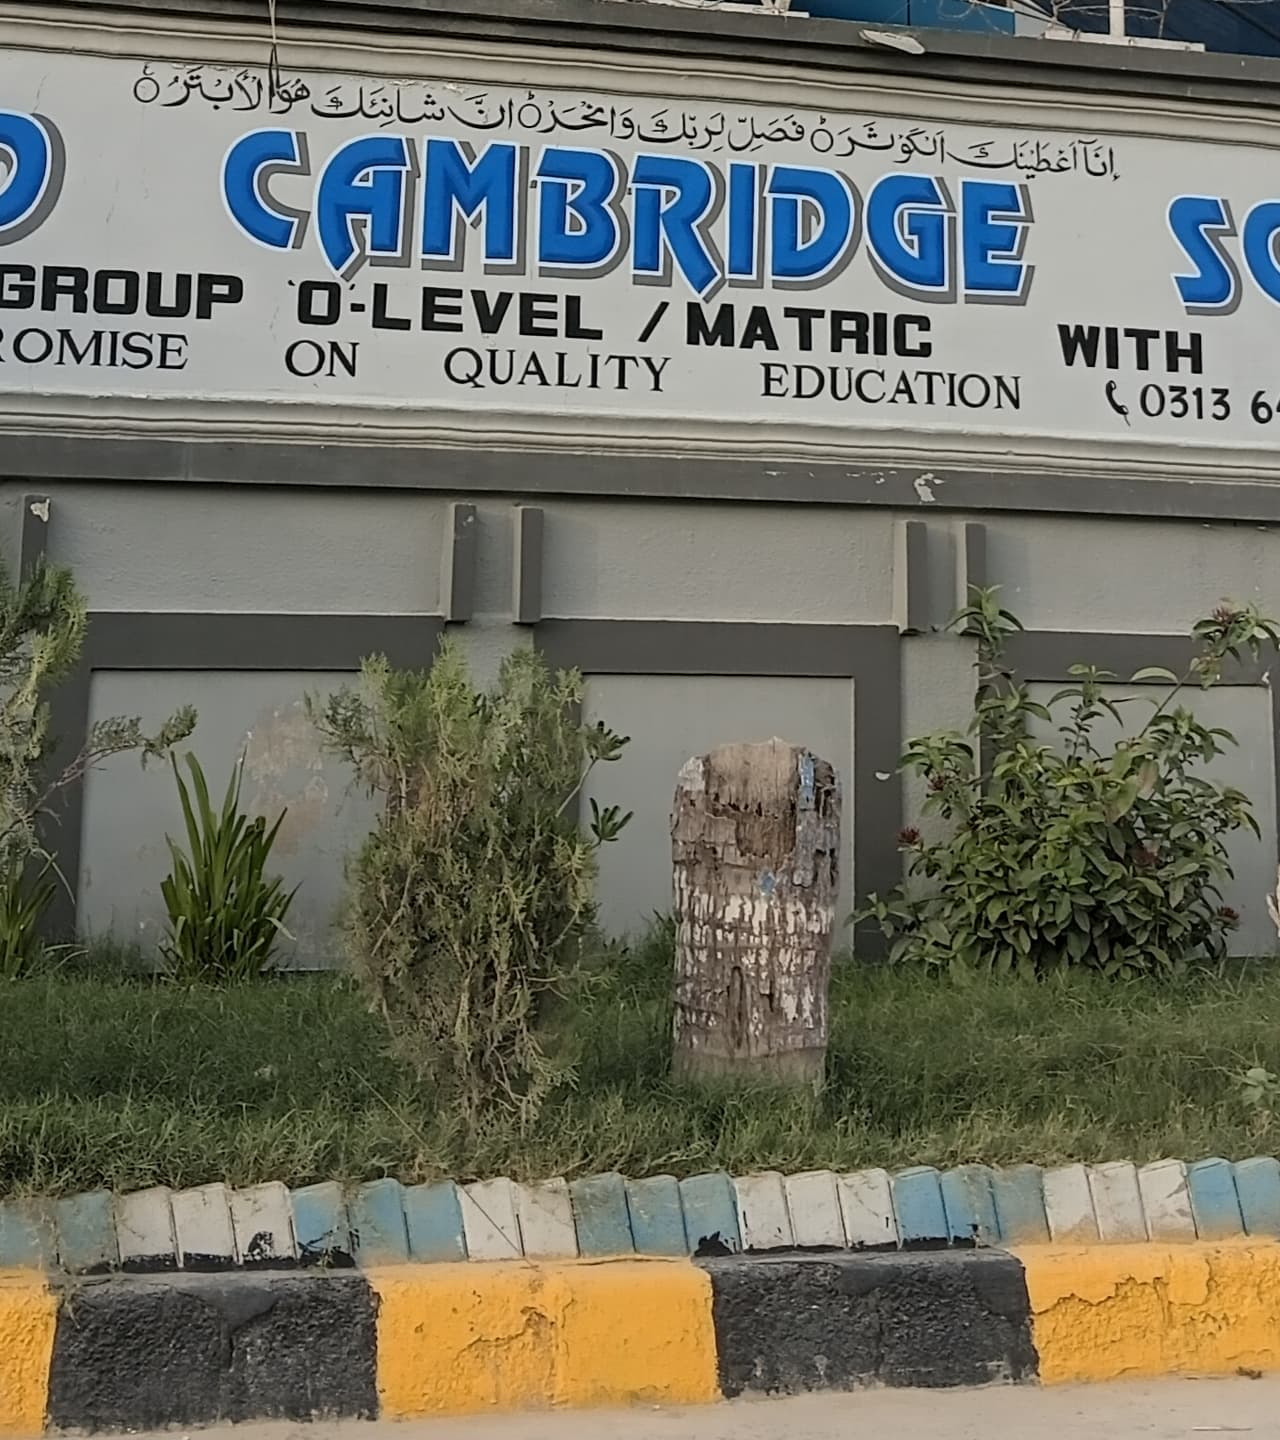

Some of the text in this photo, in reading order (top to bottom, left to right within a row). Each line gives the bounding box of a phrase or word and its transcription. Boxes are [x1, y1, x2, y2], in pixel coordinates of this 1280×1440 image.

[220, 126, 1033, 304] CAMBRIDGE
[284, 339, 359, 379] ON
[443, 346, 672, 393] QUALITY
[761, 361, 1023, 412] EDUCATION
[1057, 323, 1204, 375] WITH
[1139, 382, 1231, 422] 0313
